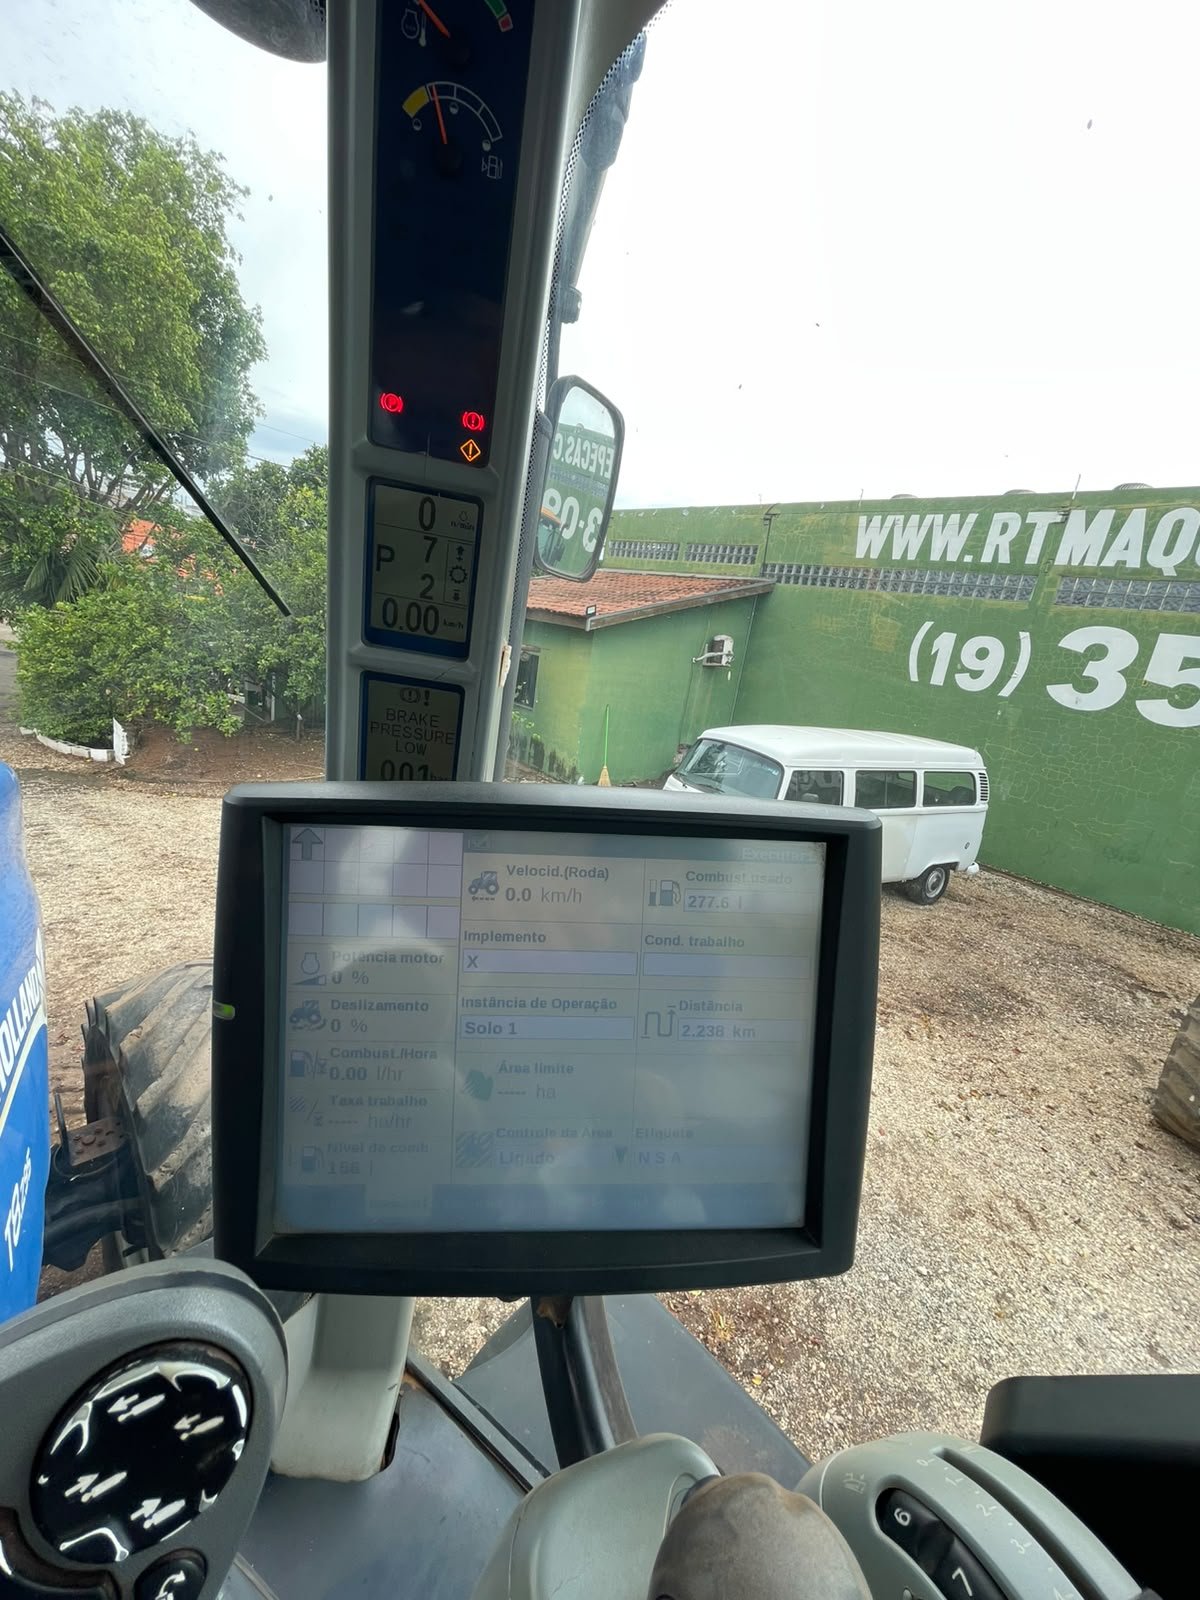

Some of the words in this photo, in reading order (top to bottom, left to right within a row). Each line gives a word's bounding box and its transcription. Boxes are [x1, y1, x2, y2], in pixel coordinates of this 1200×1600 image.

[418, 496, 437, 532] 0
[423, 535, 438, 564] 7
[855, 507, 1200, 577] WWW.RTMAQ
[375, 543, 396, 573] P
[419, 572, 436, 601] 2
[382, 596, 440, 636] 0.00
[908, 621, 1032, 698] (19)
[1046, 625, 1200, 728] 35
[385, 707, 441, 729] BRAKE
[369, 720, 457, 746] PRESSURE
[395, 738, 429, 757] LOW
[380, 759, 430, 781] 001
[506, 864, 610, 882] Velocid.(Roda)
[504, 887, 532, 903] 0.0
[540, 886, 583, 904] km/h
[687, 894, 729, 909] 277.6
[463, 929, 547, 945] Implemento
[643, 933, 684, 947] Cond.
[688, 934, 745, 949] trabalho
[331, 950, 397, 964] Potência
[399, 952, 445, 965] motor
[465, 954, 480, 969] X
[331, 972, 343, 985] 0
[351, 970, 370, 985] %
[330, 998, 430, 1013] Deslizamento
[461, 996, 528, 1010] Instância
[530, 996, 547, 1010] de
[551, 996, 618, 1013] Operação
[678, 999, 744, 1013] Distância
[330, 1018, 342, 1033] 0
[351, 1018, 369, 1033] %
[464, 1021, 503, 1035] Solo
[508, 1021, 518, 1035] 1
[681, 1024, 725, 1038] 2.238
[732, 1024, 757, 1038] km
[329, 1046, 438, 1060] Combust./Hora
[329, 1065, 368, 1082] 0.00
[376, 1064, 405, 1081] l/hr
[497, 1059, 531, 1074] Área
[533, 1061, 575, 1075] limite
[536, 1083, 557, 1100] ha
[329, 1094, 364, 1107] Taxa
[367, 1094, 428, 1108] trabalho
[893, 1507, 912, 1527] 6
[951, 1566, 973, 1598] 7
